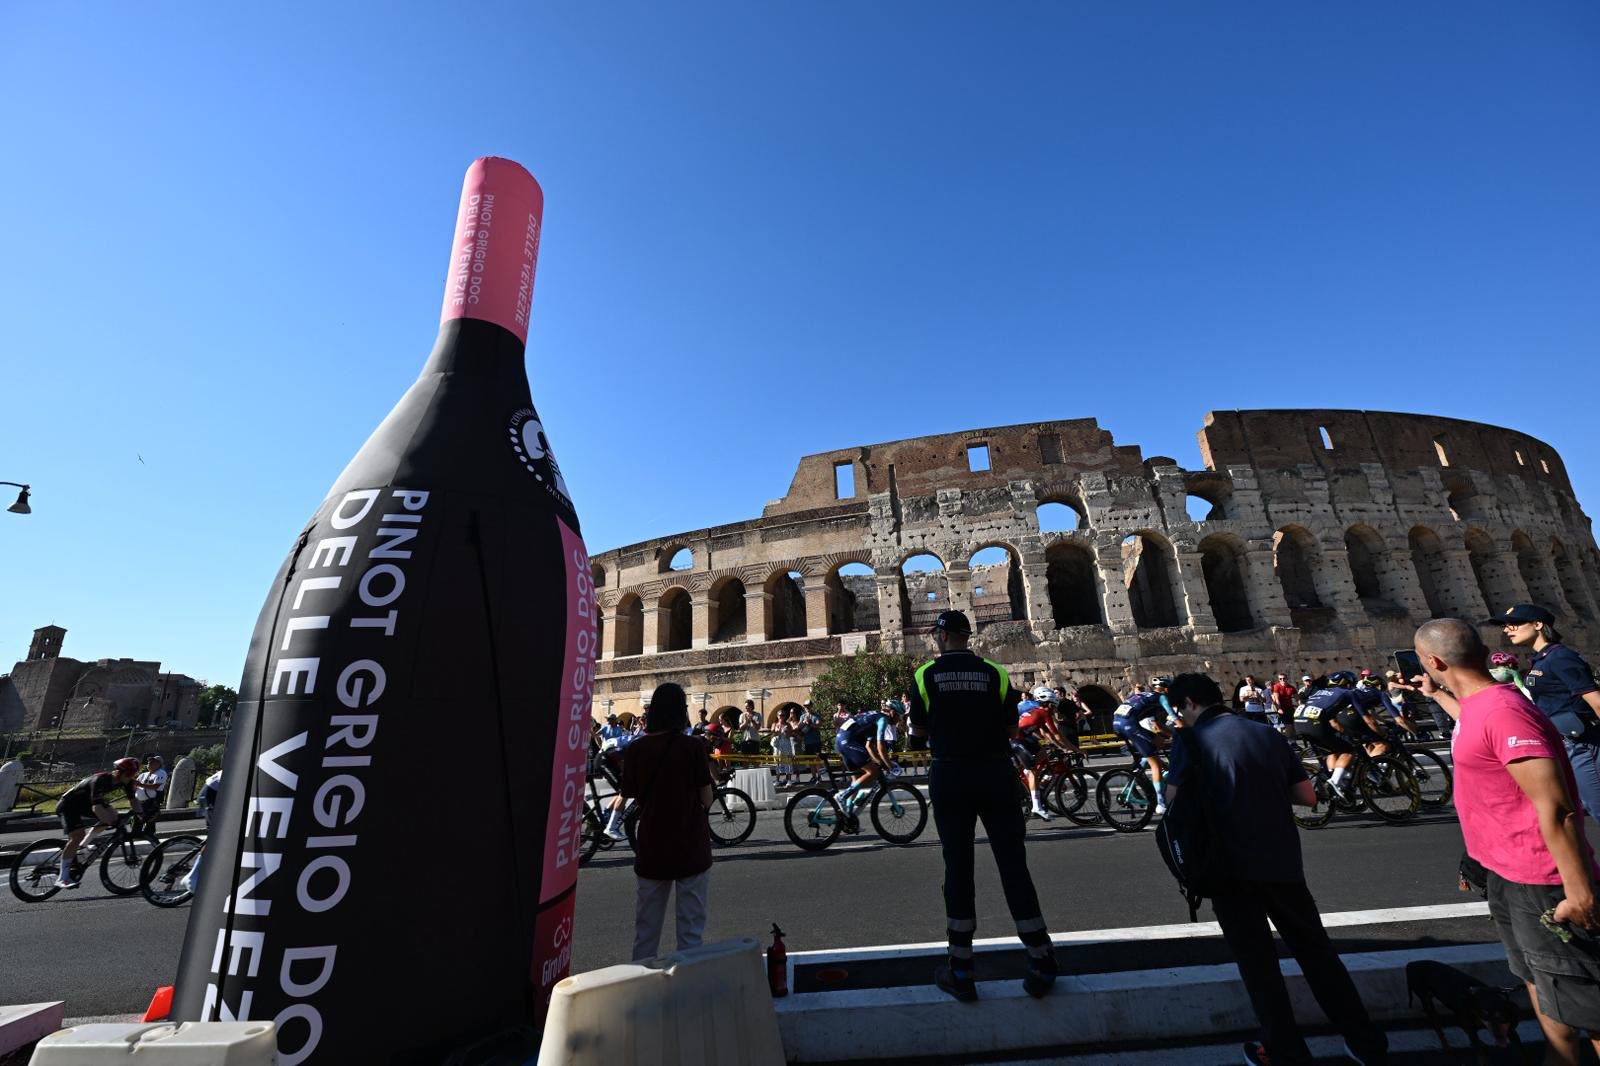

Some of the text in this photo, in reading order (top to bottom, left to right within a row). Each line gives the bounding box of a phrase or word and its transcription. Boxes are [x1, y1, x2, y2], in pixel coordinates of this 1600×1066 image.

[454, 194, 480, 306] DELLE VENEZIE
[467, 194, 494, 305] PINOT GRIGIO DOC
[514, 263, 531, 326] VENEZIE
[523, 213, 537, 260] DELLE
[270, 488, 381, 696] DELLE
[349, 489, 430, 636] PINOT
[555, 549, 589, 868] PINOT GRIGIO DOC
[296, 658, 387, 913] GRIGIO
